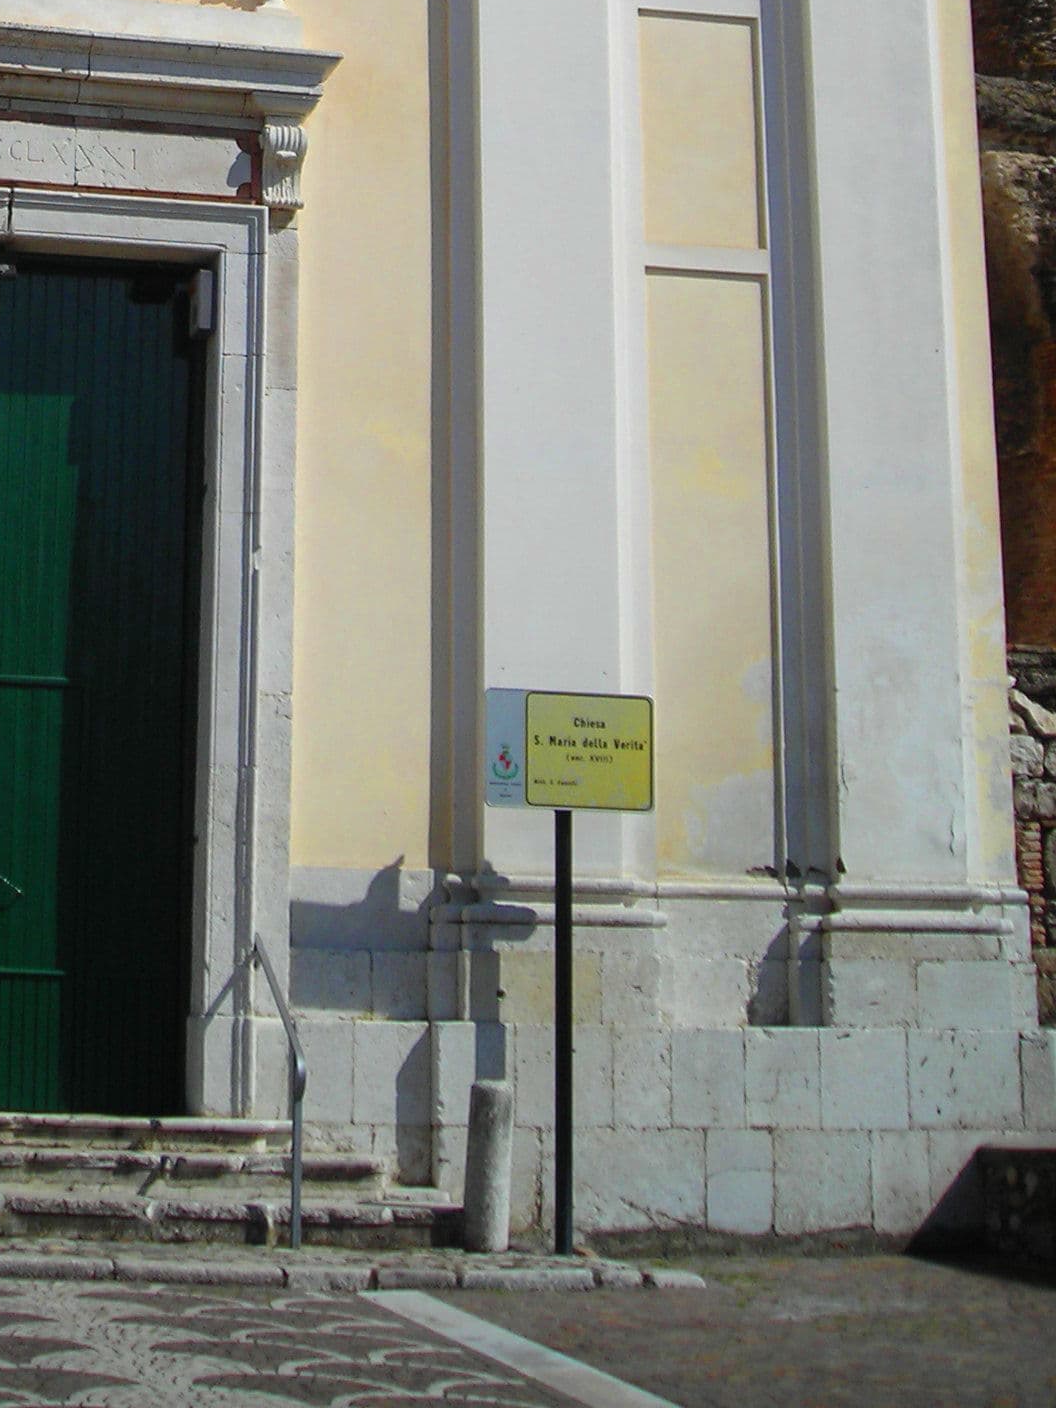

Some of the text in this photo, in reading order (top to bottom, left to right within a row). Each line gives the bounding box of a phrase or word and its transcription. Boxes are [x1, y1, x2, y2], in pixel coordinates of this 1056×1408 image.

[573, 717, 606, 730] Chiesa
[534, 735, 544, 746] S.
[549, 735, 577, 748] Maria
[582, 736, 608, 750] della
